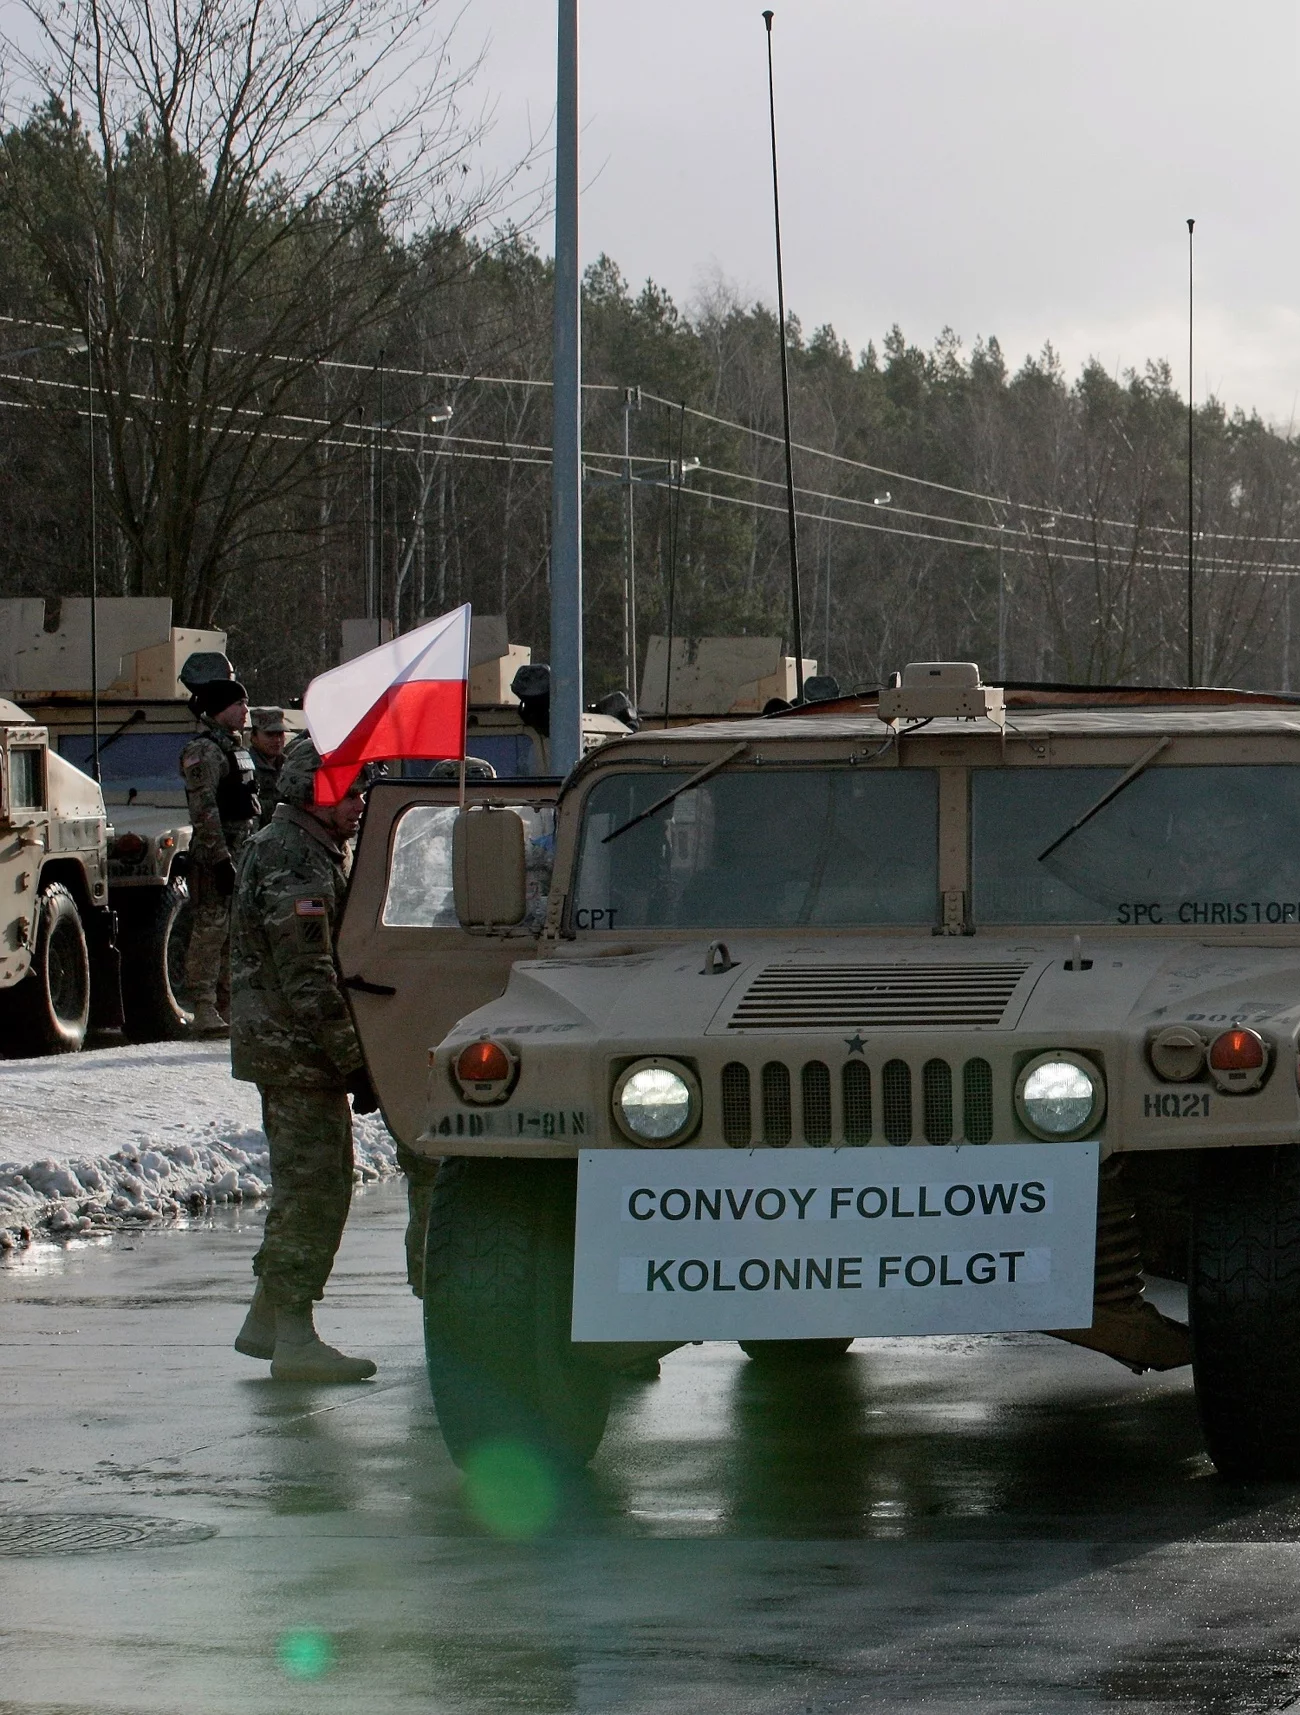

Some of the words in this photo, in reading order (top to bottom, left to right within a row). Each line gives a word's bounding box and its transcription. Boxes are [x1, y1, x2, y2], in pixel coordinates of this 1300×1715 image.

[575, 908, 619, 930] CPT
[1117, 902, 1164, 925] SPC
[1143, 1093, 1210, 1118] HQ21
[627, 1187, 818, 1222] CONVOY
[829, 1181, 1047, 1220] FOLLOWS
[646, 1256, 863, 1293] KOLONNE
[878, 1250, 1026, 1289] FOLGT
